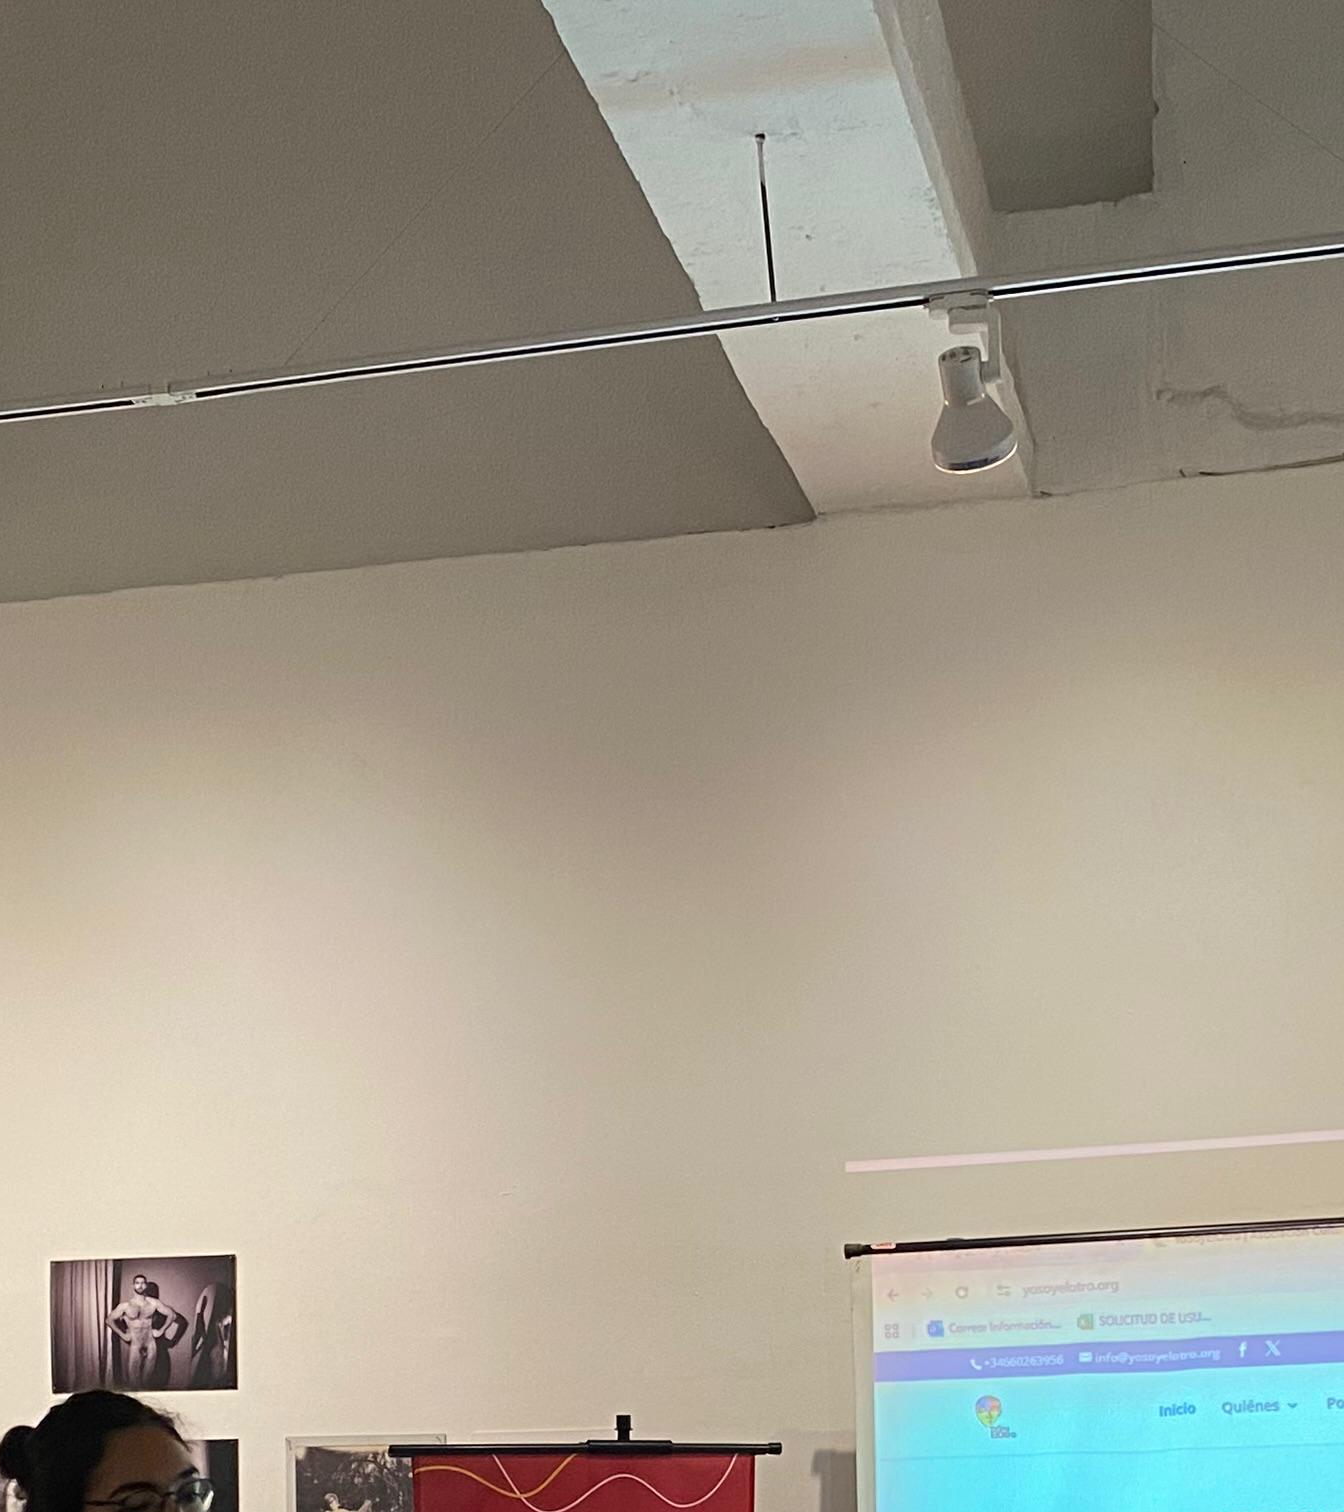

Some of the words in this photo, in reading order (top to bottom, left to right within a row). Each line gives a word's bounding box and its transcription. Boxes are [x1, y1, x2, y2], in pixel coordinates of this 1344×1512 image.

[1099, 1313, 1157, 1326] SOLICITUD
[1160, 1312, 1175, 1324] DE
[1159, 1402, 1196, 1417] Inicio
